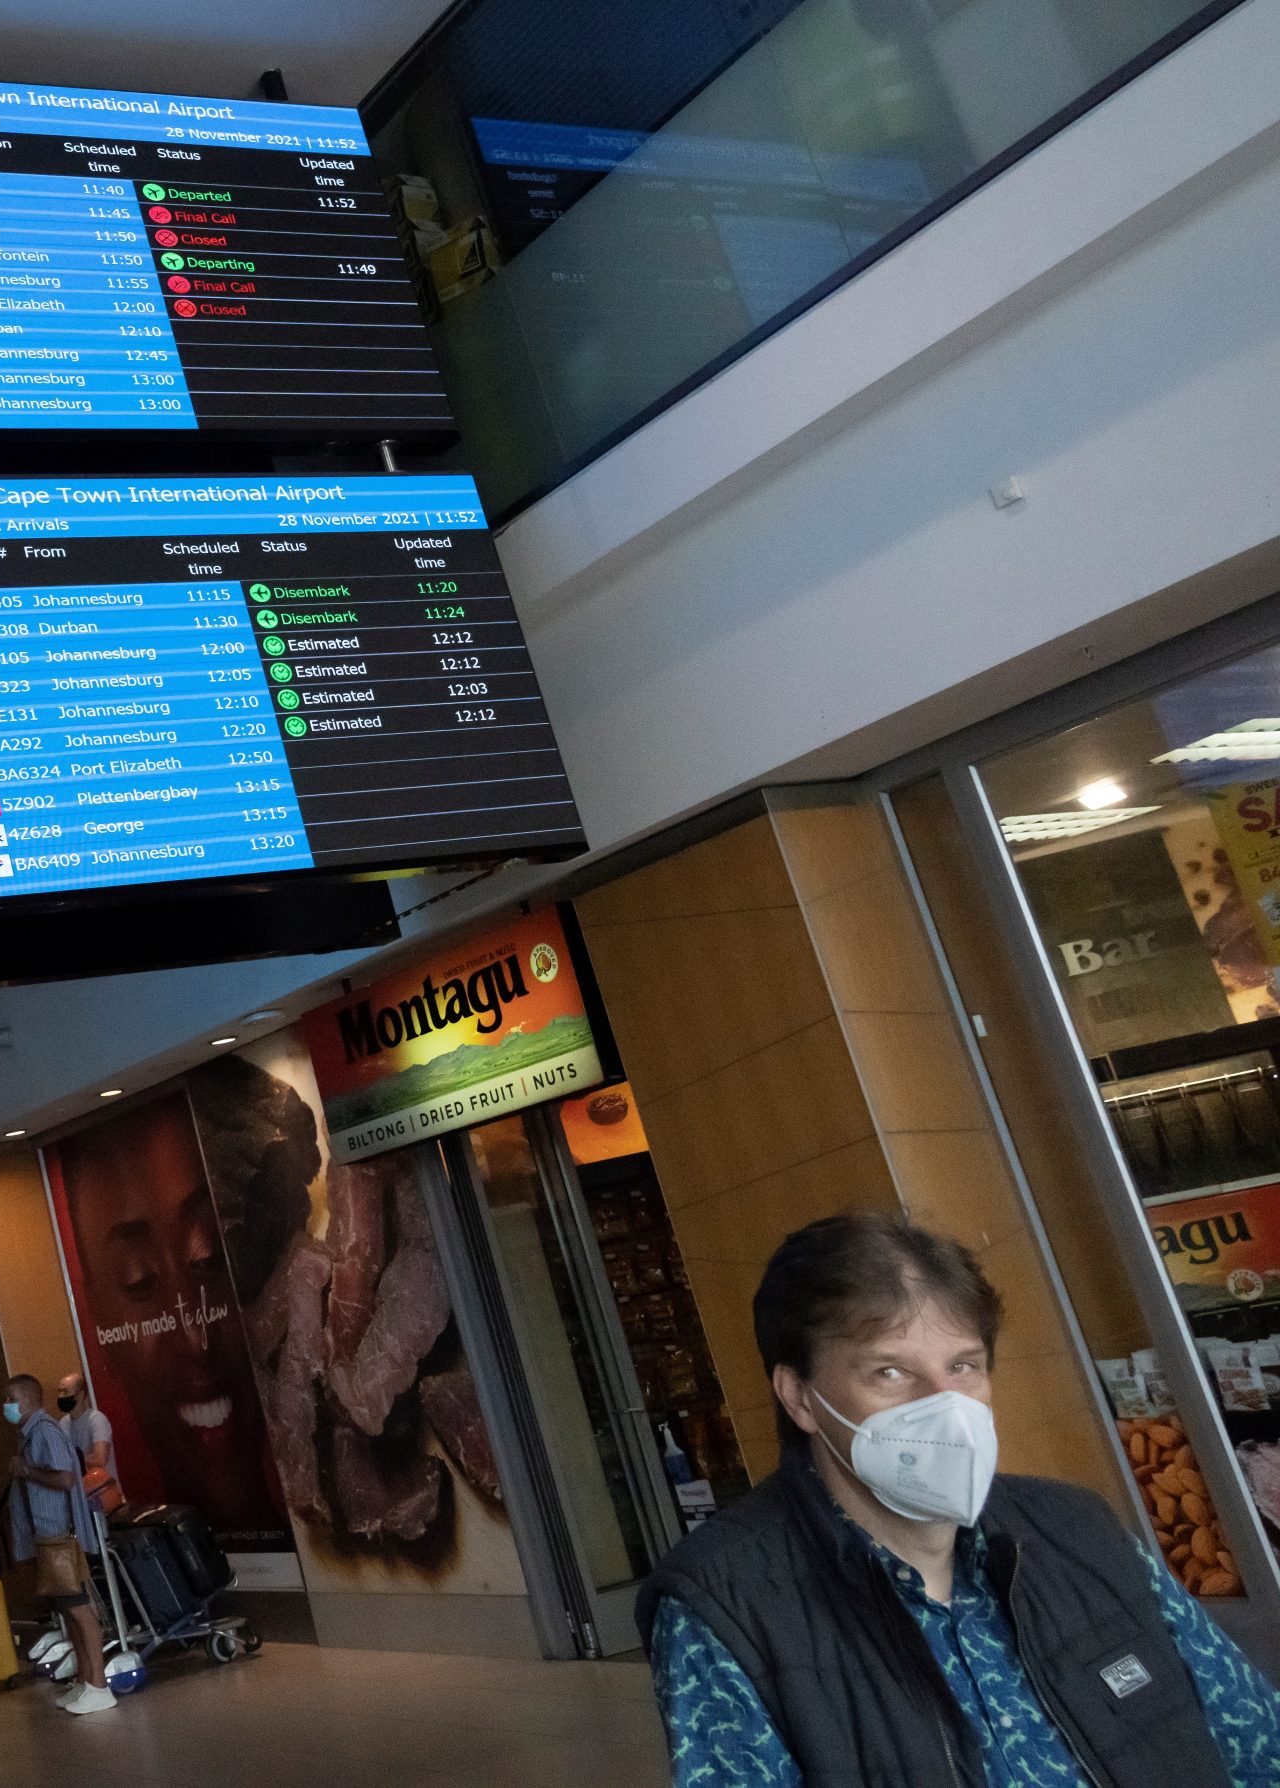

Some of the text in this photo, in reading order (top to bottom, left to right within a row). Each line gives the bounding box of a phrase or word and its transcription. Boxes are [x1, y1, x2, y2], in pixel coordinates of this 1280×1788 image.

[27, 91, 160, 115] International
[168, 102, 234, 119] Airport
[166, 128, 357, 149] 28 November 2021 11:52
[157, 149, 200, 160] Status
[300, 158, 354, 171] Updated
[315, 176, 344, 186] time
[83, 184, 124, 196] 11:40
[168, 189, 231, 202] Departed
[318, 198, 356, 208] 11:52
[176, 212, 236, 224] Final Call
[188, 257, 376, 274] Departing 11:49
[56, 488, 121, 503] Town
[130, 486, 267, 503] International
[276, 486, 346, 503] Airport
[6, 518, 69, 532] Arrivals
[278, 511, 477, 526] 28 November 2021 11:52
[163, 542, 239, 556] Scheduled
[261, 540, 307, 553] Status
[33, 591, 143, 609] Johannesburg
[187, 589, 231, 601] 11:15
[274, 585, 350, 599] Disembark
[417, 581, 457, 594] 11:20
[45, 646, 157, 664] Johannesburg
[200, 642, 245, 655] 12:00
[288, 637, 359, 651] Estimated
[433, 632, 473, 644] 12:12
[2, 795, 56, 811] 5Z902
[78, 785, 198, 806] Plettenbergbay
[1059, 929, 1157, 977] Bar
[336, 952, 529, 1064] Montagu
[348, 1063, 577, 1151] BILTONG DRIED FRUIT NUTS
[97, 1321, 138, 1345] beauty
[142, 1311, 176, 1337] made
[194, 1285, 228, 1350] glow
